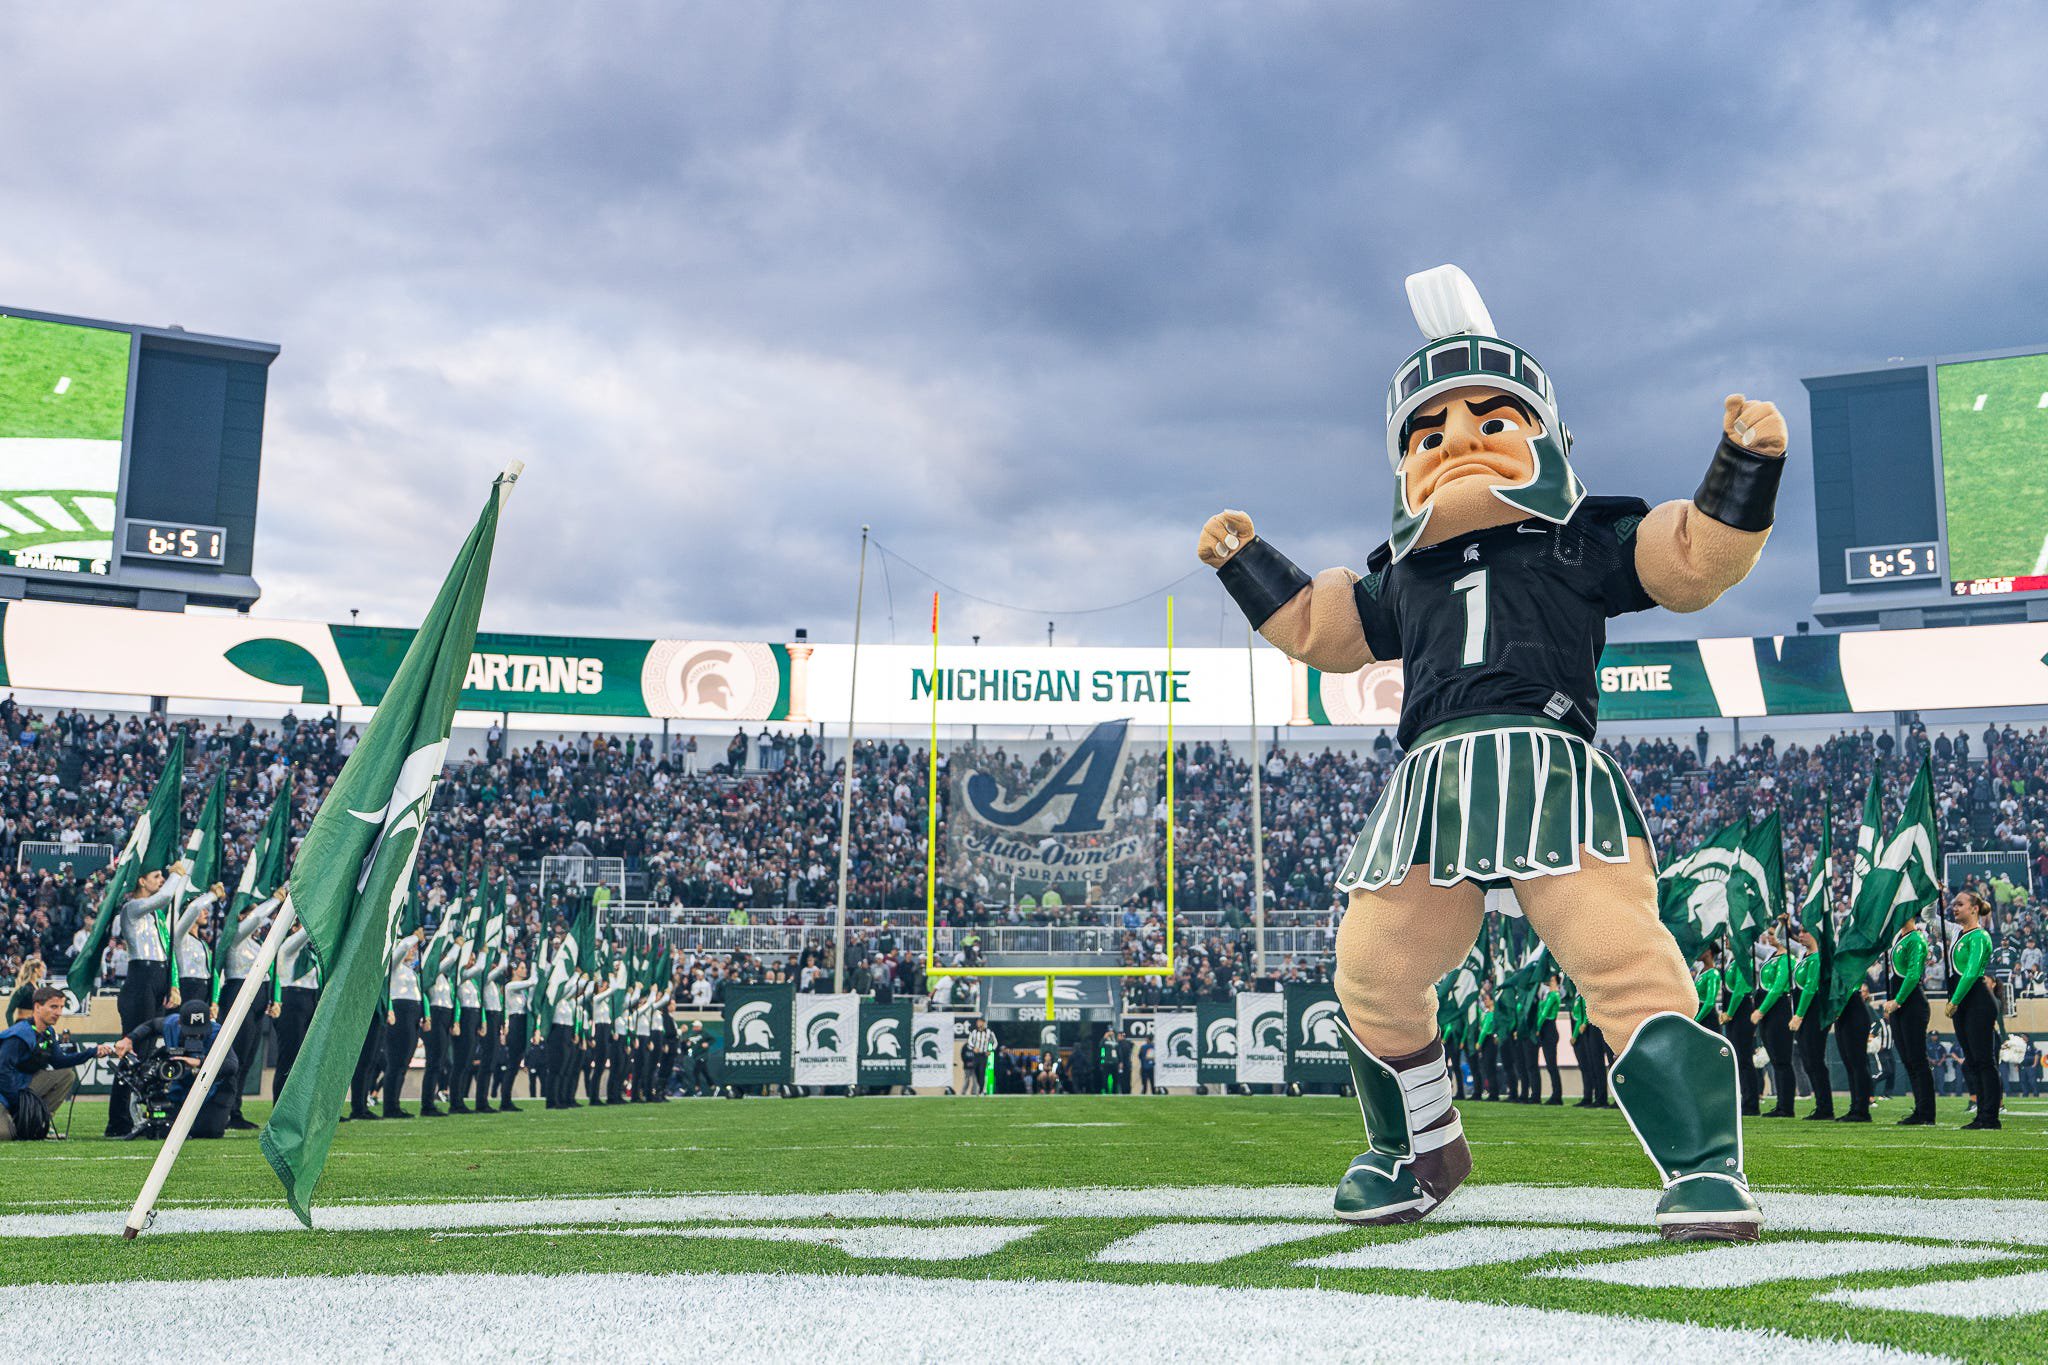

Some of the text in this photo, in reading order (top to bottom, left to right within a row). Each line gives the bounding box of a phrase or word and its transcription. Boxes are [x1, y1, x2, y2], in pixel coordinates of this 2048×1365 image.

[148, 528, 219, 558] 6:51
[1869, 548, 1934, 578] 6:51
[1451, 568, 1488, 667] 1
[462, 652, 604, 695] ARTANS
[910, 668, 1192, 702] MICHIGAN STATE
[1600, 664, 1673, 693] STATE
[966, 835, 1137, 866] Auto-Owners
[997, 863, 1104, 882] INSURANCE
